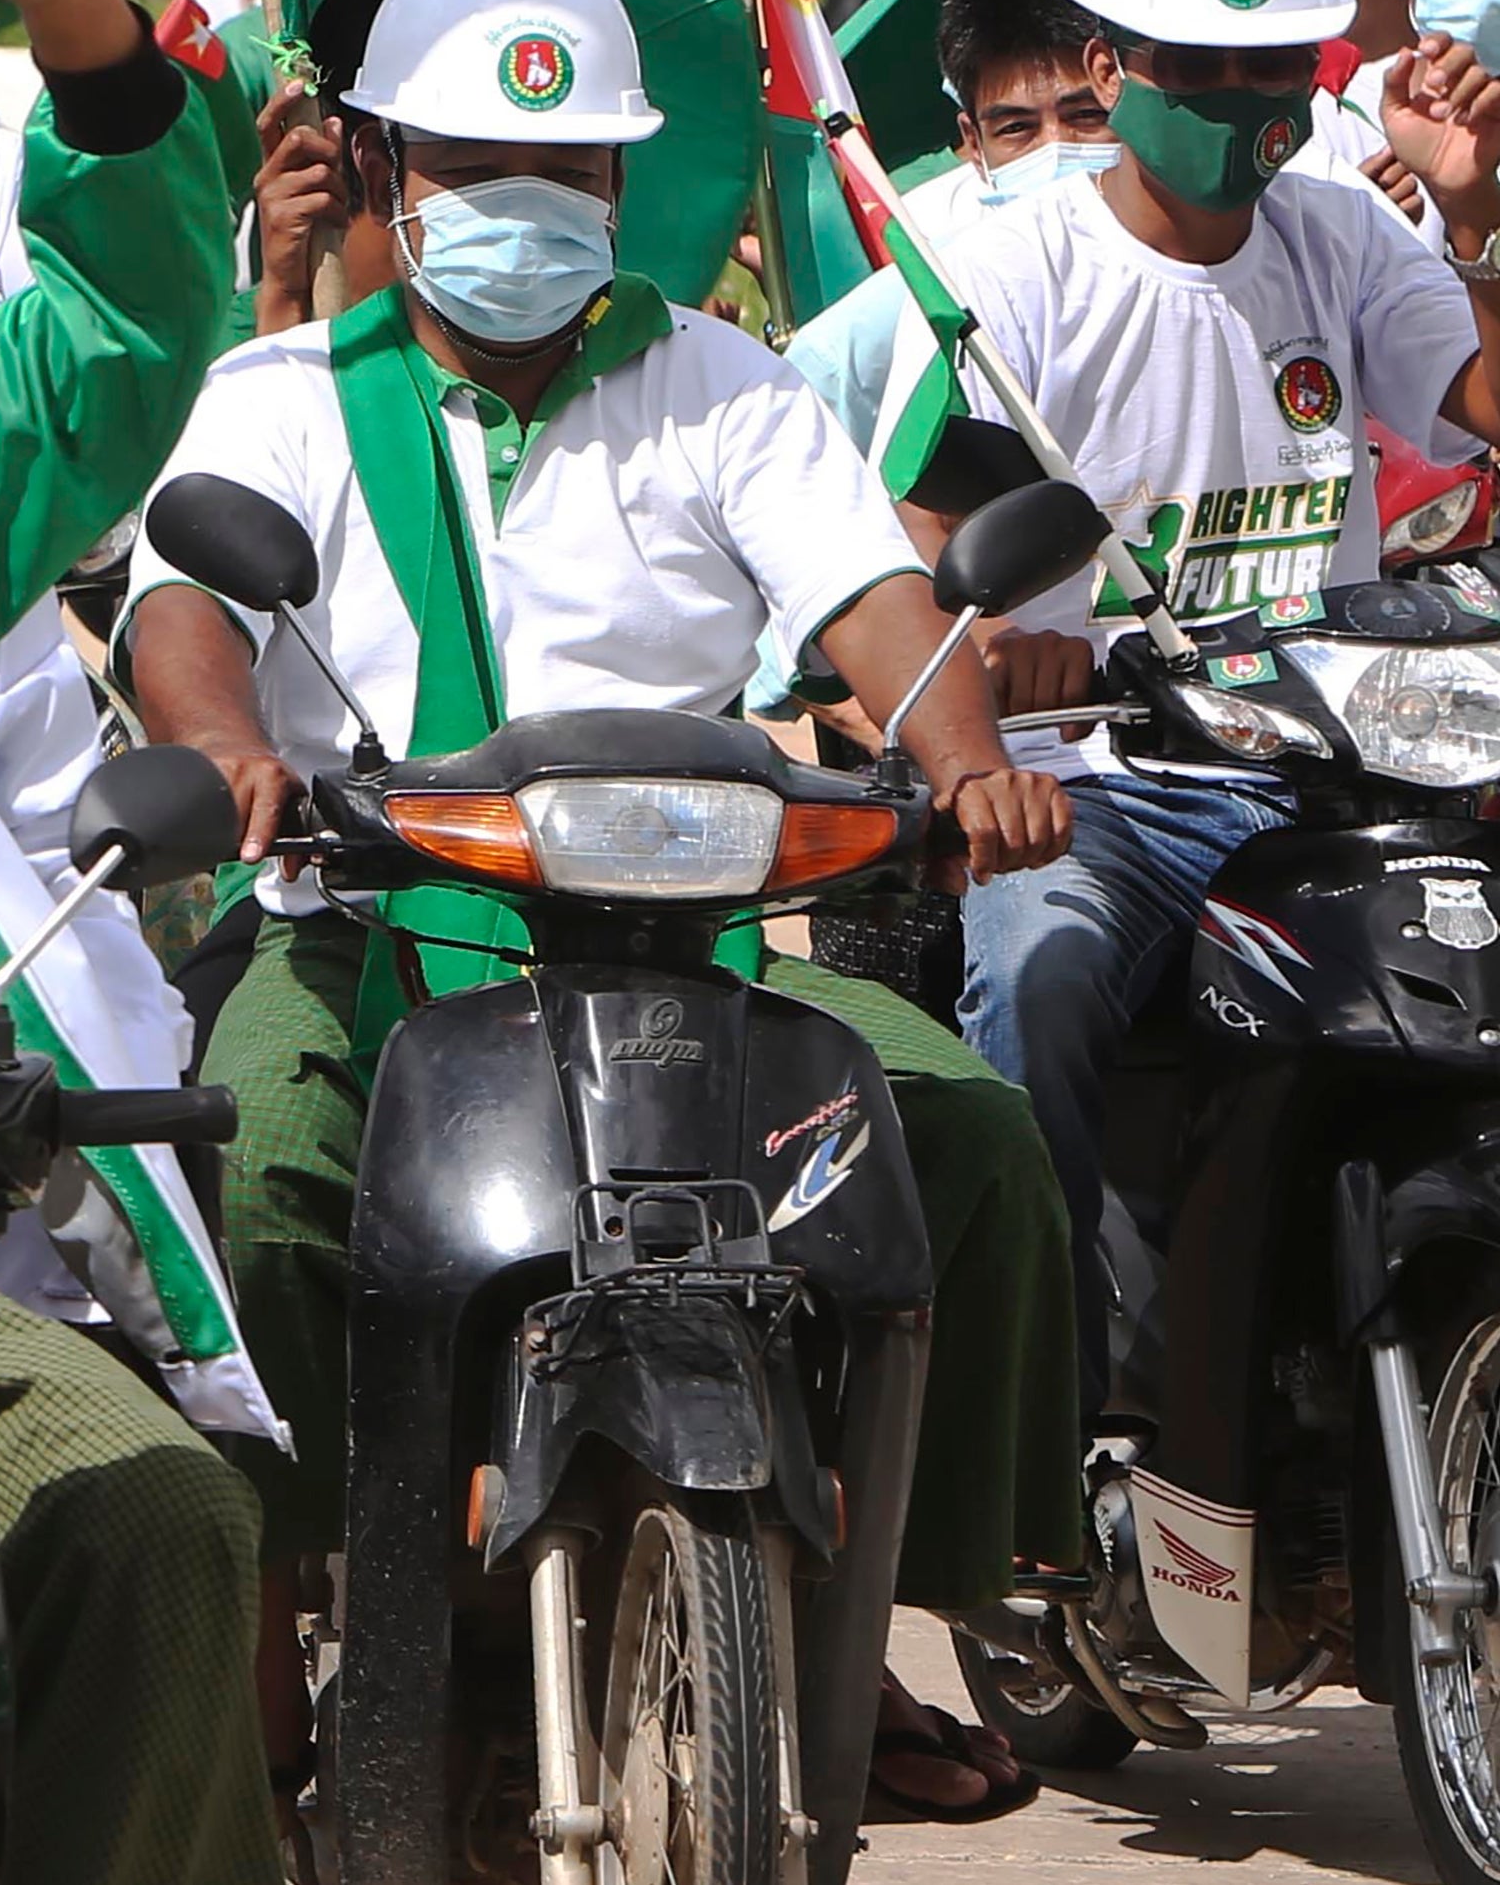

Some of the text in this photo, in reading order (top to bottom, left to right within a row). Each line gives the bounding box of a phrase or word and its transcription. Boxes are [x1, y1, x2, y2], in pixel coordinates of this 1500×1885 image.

[1174, 544, 1332, 615] FUTUR
[1384, 855, 1492, 873] HONDA
[1199, 984, 1268, 1037] NCX
[1151, 1564, 1242, 1603] HONDA
